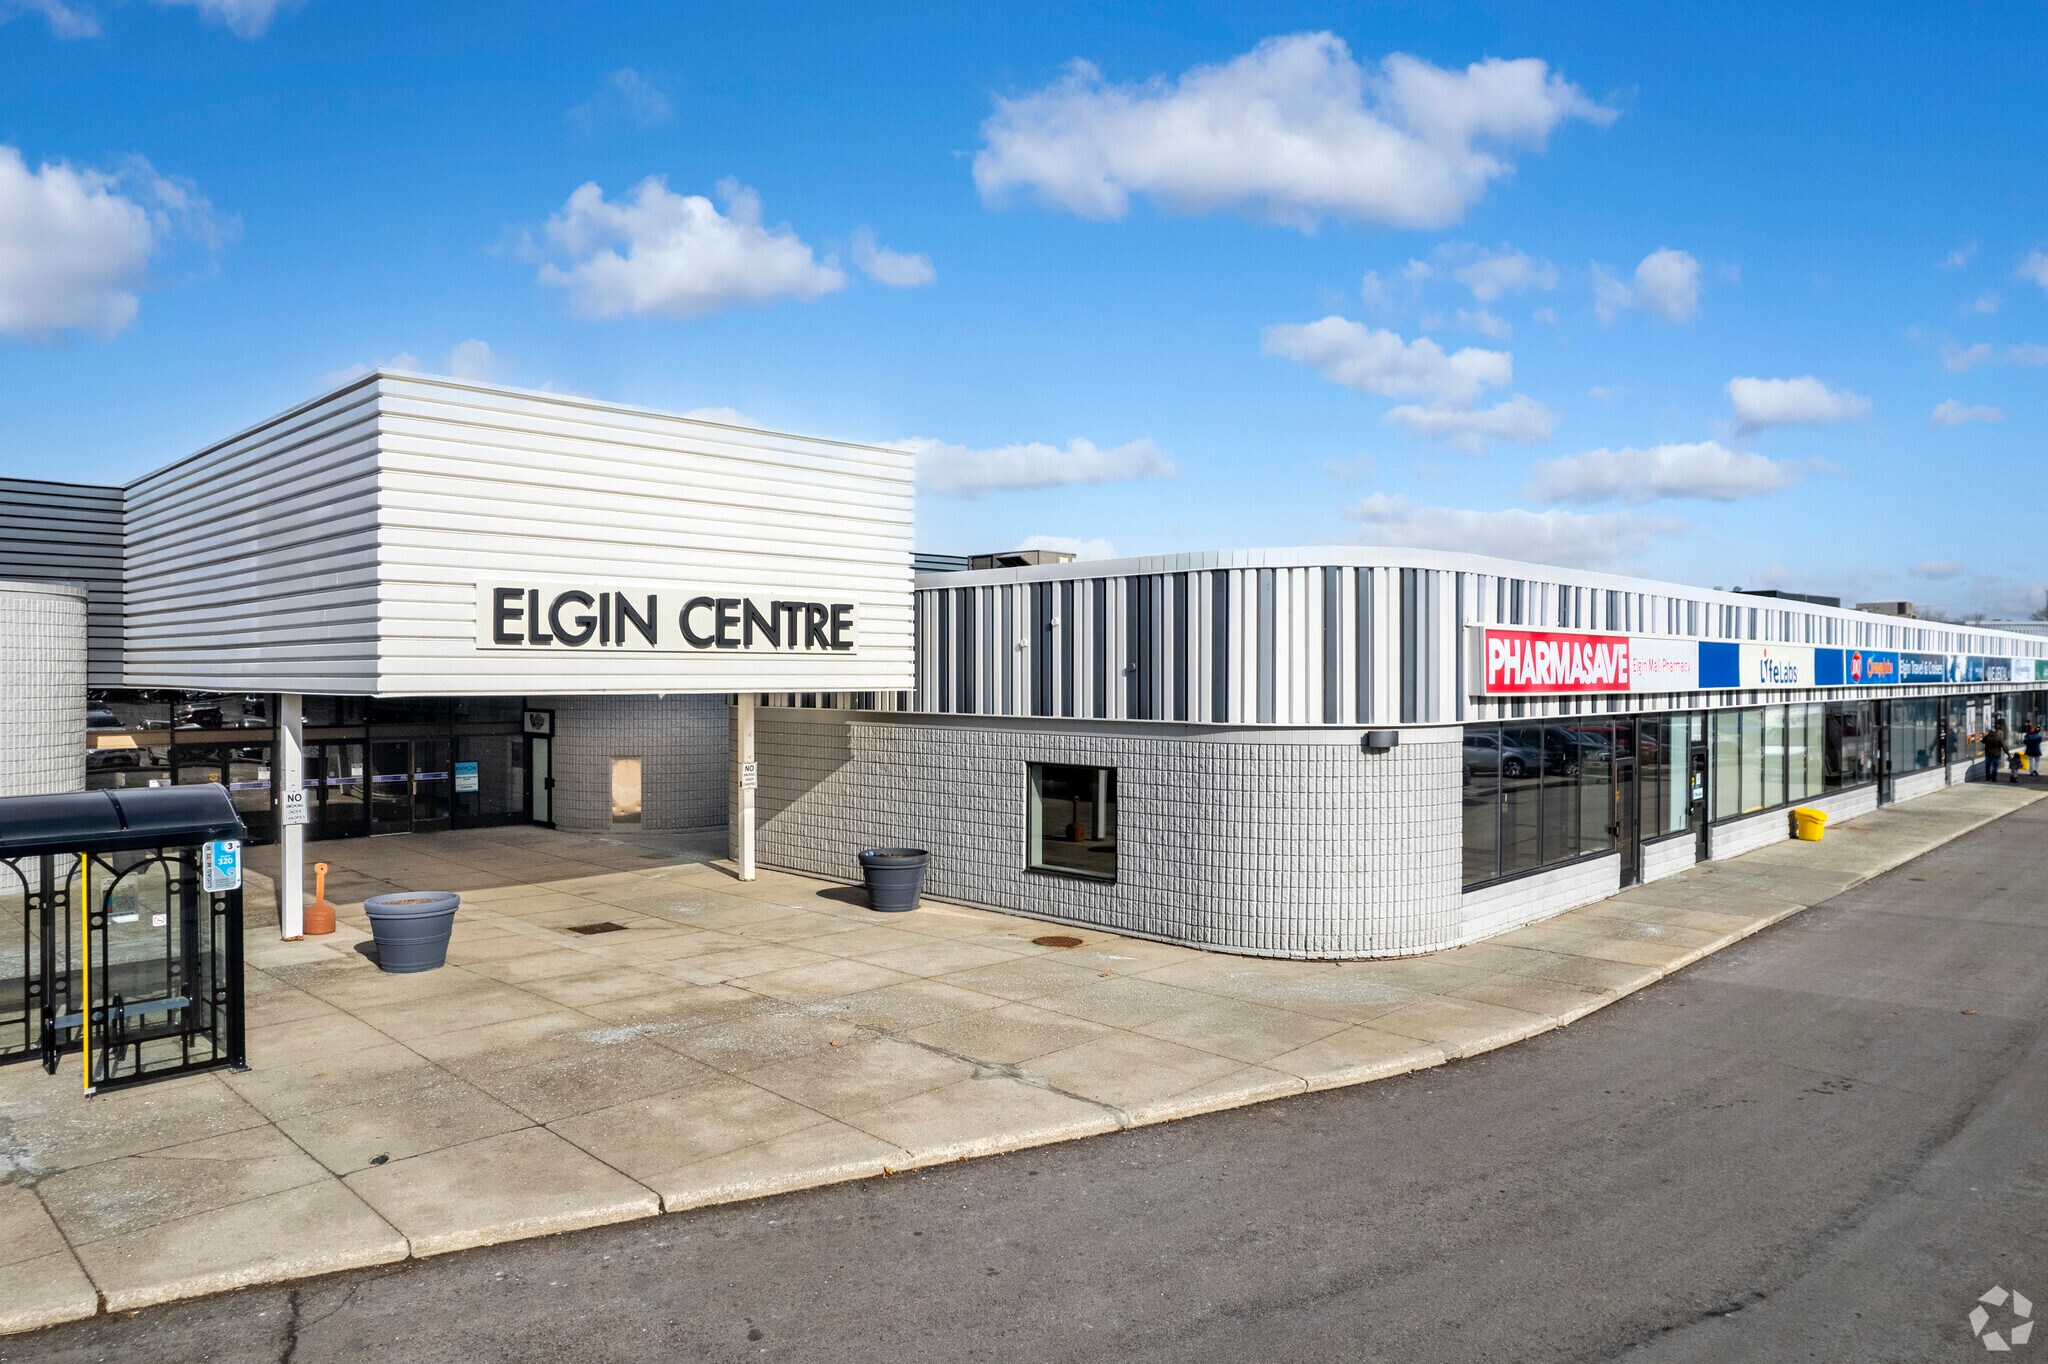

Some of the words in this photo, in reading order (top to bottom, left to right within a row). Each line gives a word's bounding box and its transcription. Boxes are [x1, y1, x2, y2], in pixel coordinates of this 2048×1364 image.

[493, 587, 657, 648] ELGIN
[679, 596, 854, 650] CENTRE
[1488, 638, 1628, 685] PHARMASAVE
[1633, 657, 1647, 676] Elgin
[1648, 658, 1661, 672] Mall
[1662, 658, 1691, 675] Pharmacy
[1760, 648, 1798, 683] LifeLabs
[287, 793, 302, 802] NO
